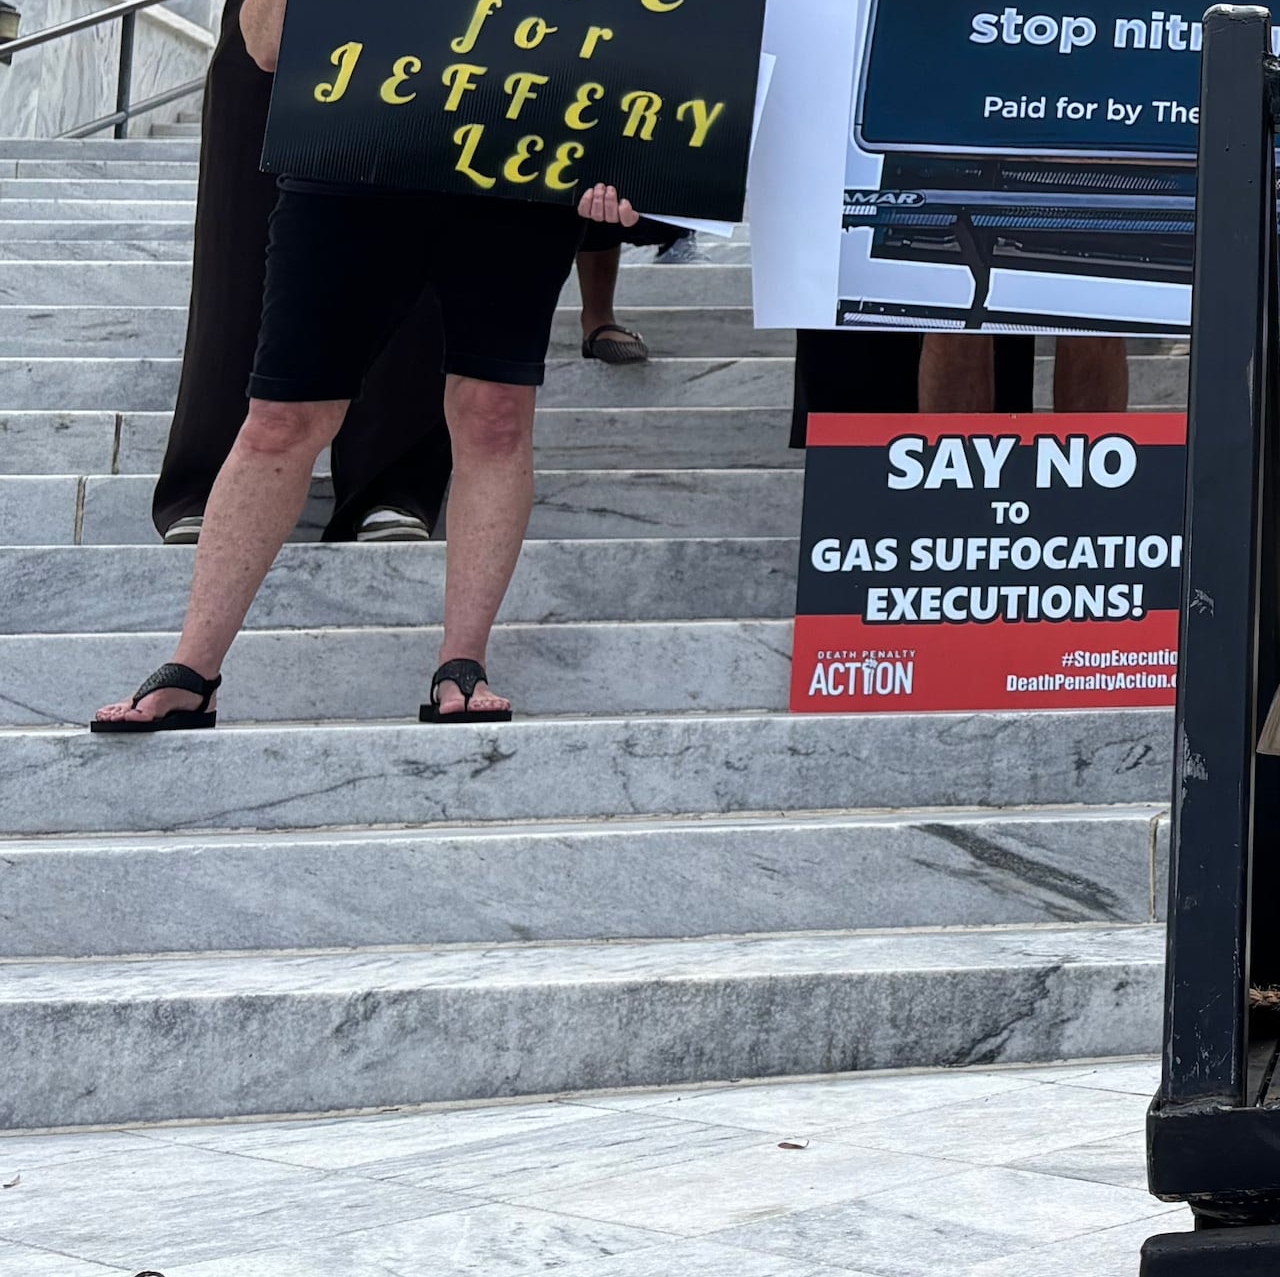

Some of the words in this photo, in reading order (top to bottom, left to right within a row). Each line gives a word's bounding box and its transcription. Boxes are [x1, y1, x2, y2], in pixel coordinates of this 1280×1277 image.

[969, 6, 1097, 54] stop
[313, 40, 726, 148] JEFFERY
[983, 95, 1047, 121] Paid
[1055, 96, 1098, 121] for
[1107, 98, 1143, 125] by
[452, 123, 586, 192] LEE
[844, 192, 918, 205] AMAR
[887, 436, 1015, 491] SAY
[1036, 436, 1138, 489] NO
[991, 501, 1030, 525] TO
[811, 537, 898, 572] GAS
[866, 583, 1144, 621] EXECUTIONS!
[817, 650, 857, 660] DEATH
[862, 649, 916, 660] PENALTY
[1061, 648, 1178, 668] #StopExecutio
[808, 658, 914, 697] ACTION
[1006, 671, 1177, 692] DeathPenaltyAction.
